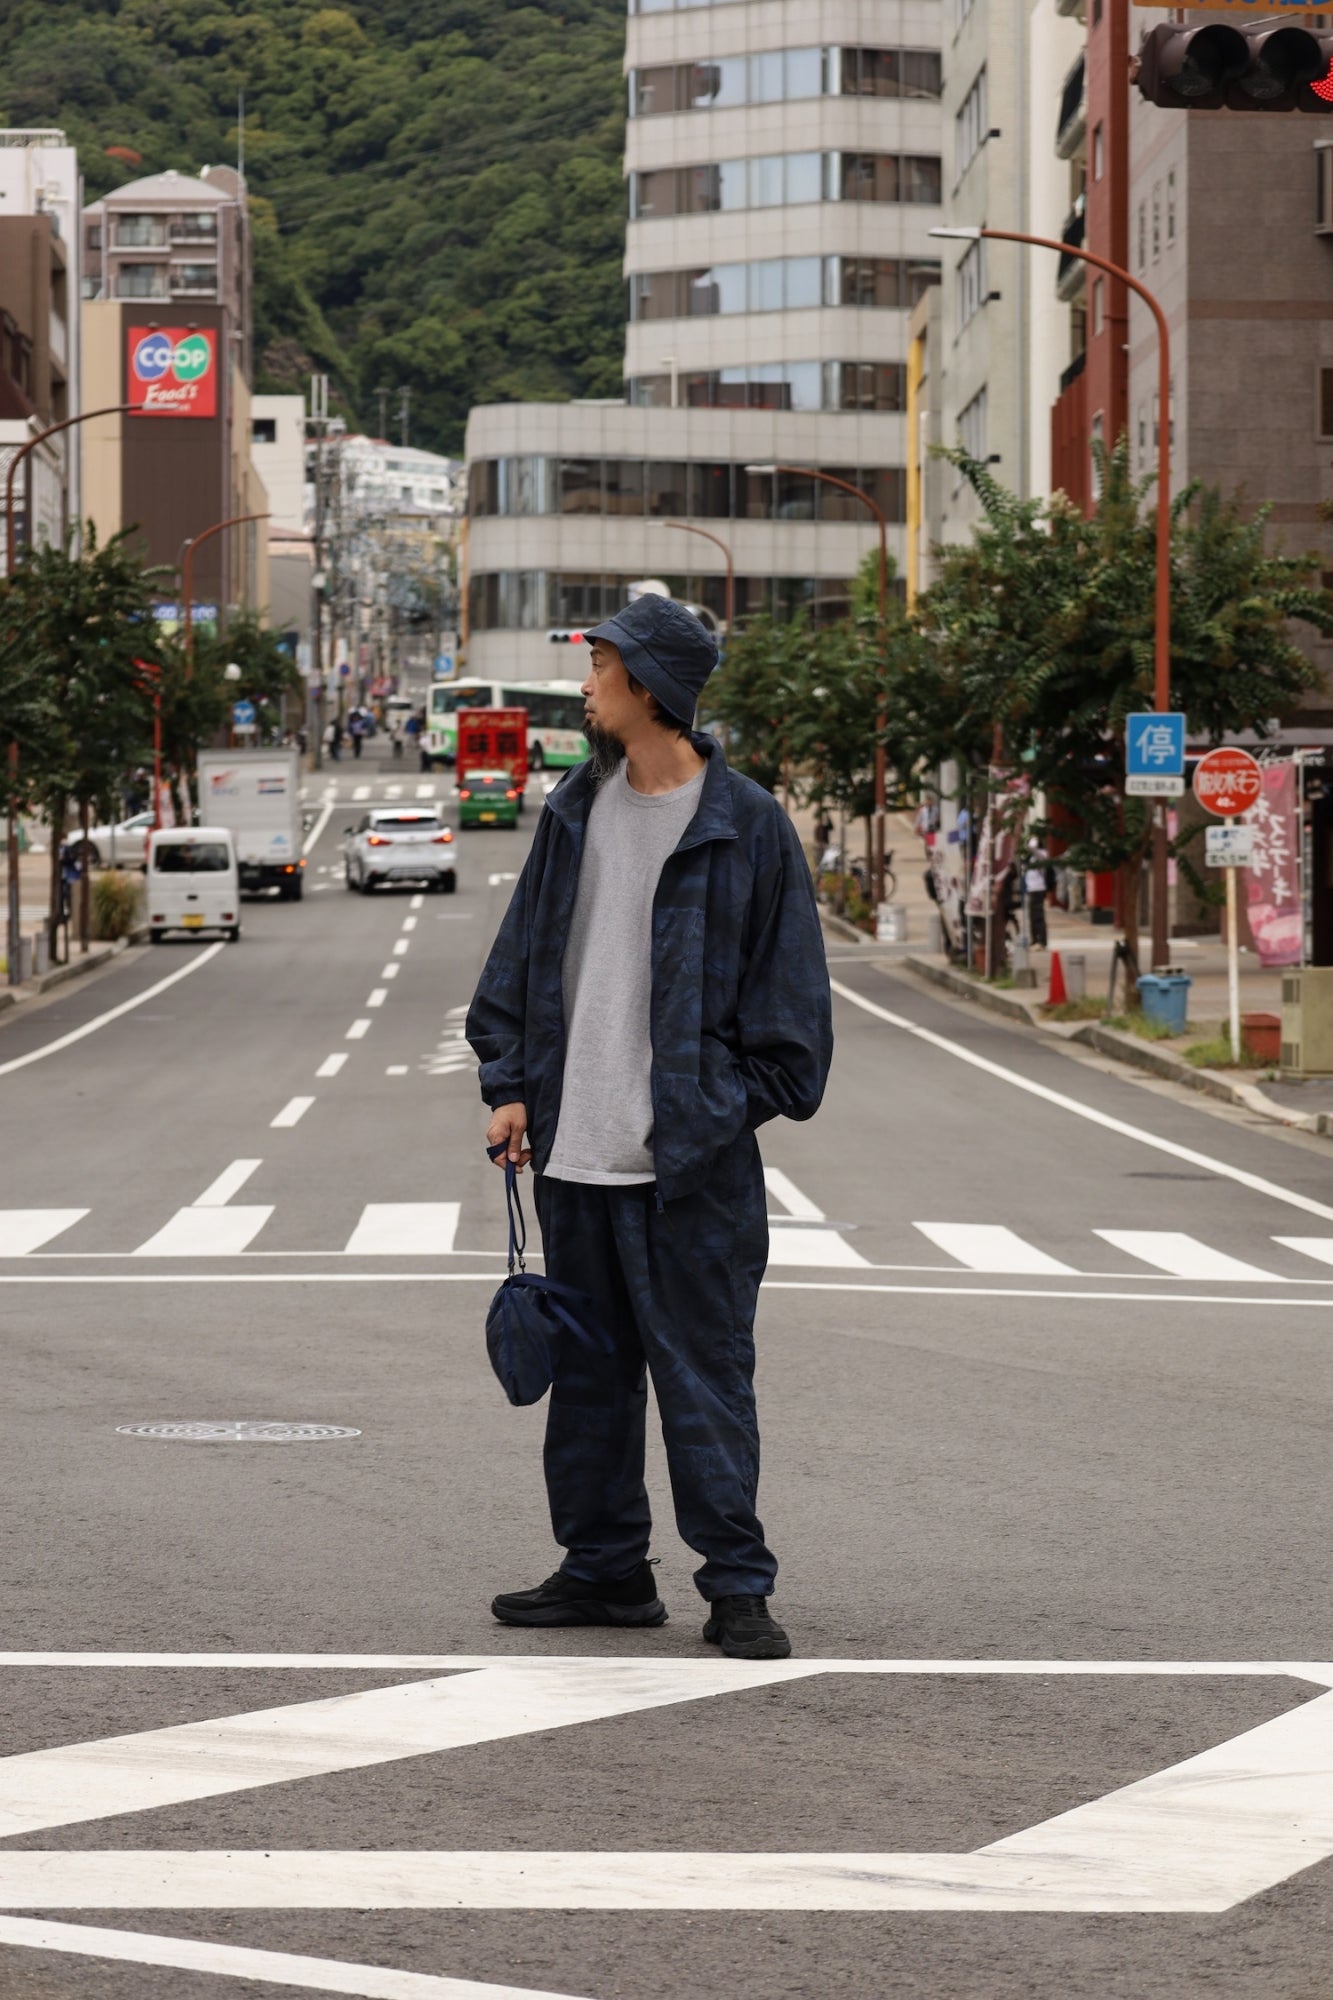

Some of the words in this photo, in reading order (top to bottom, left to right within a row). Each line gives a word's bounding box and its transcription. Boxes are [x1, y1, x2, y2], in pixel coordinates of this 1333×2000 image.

[1136, 725, 1176, 765] 停
[1198, 769, 1260, 796] 防火水そう
[1268, 814, 1293, 906] ステーキ
